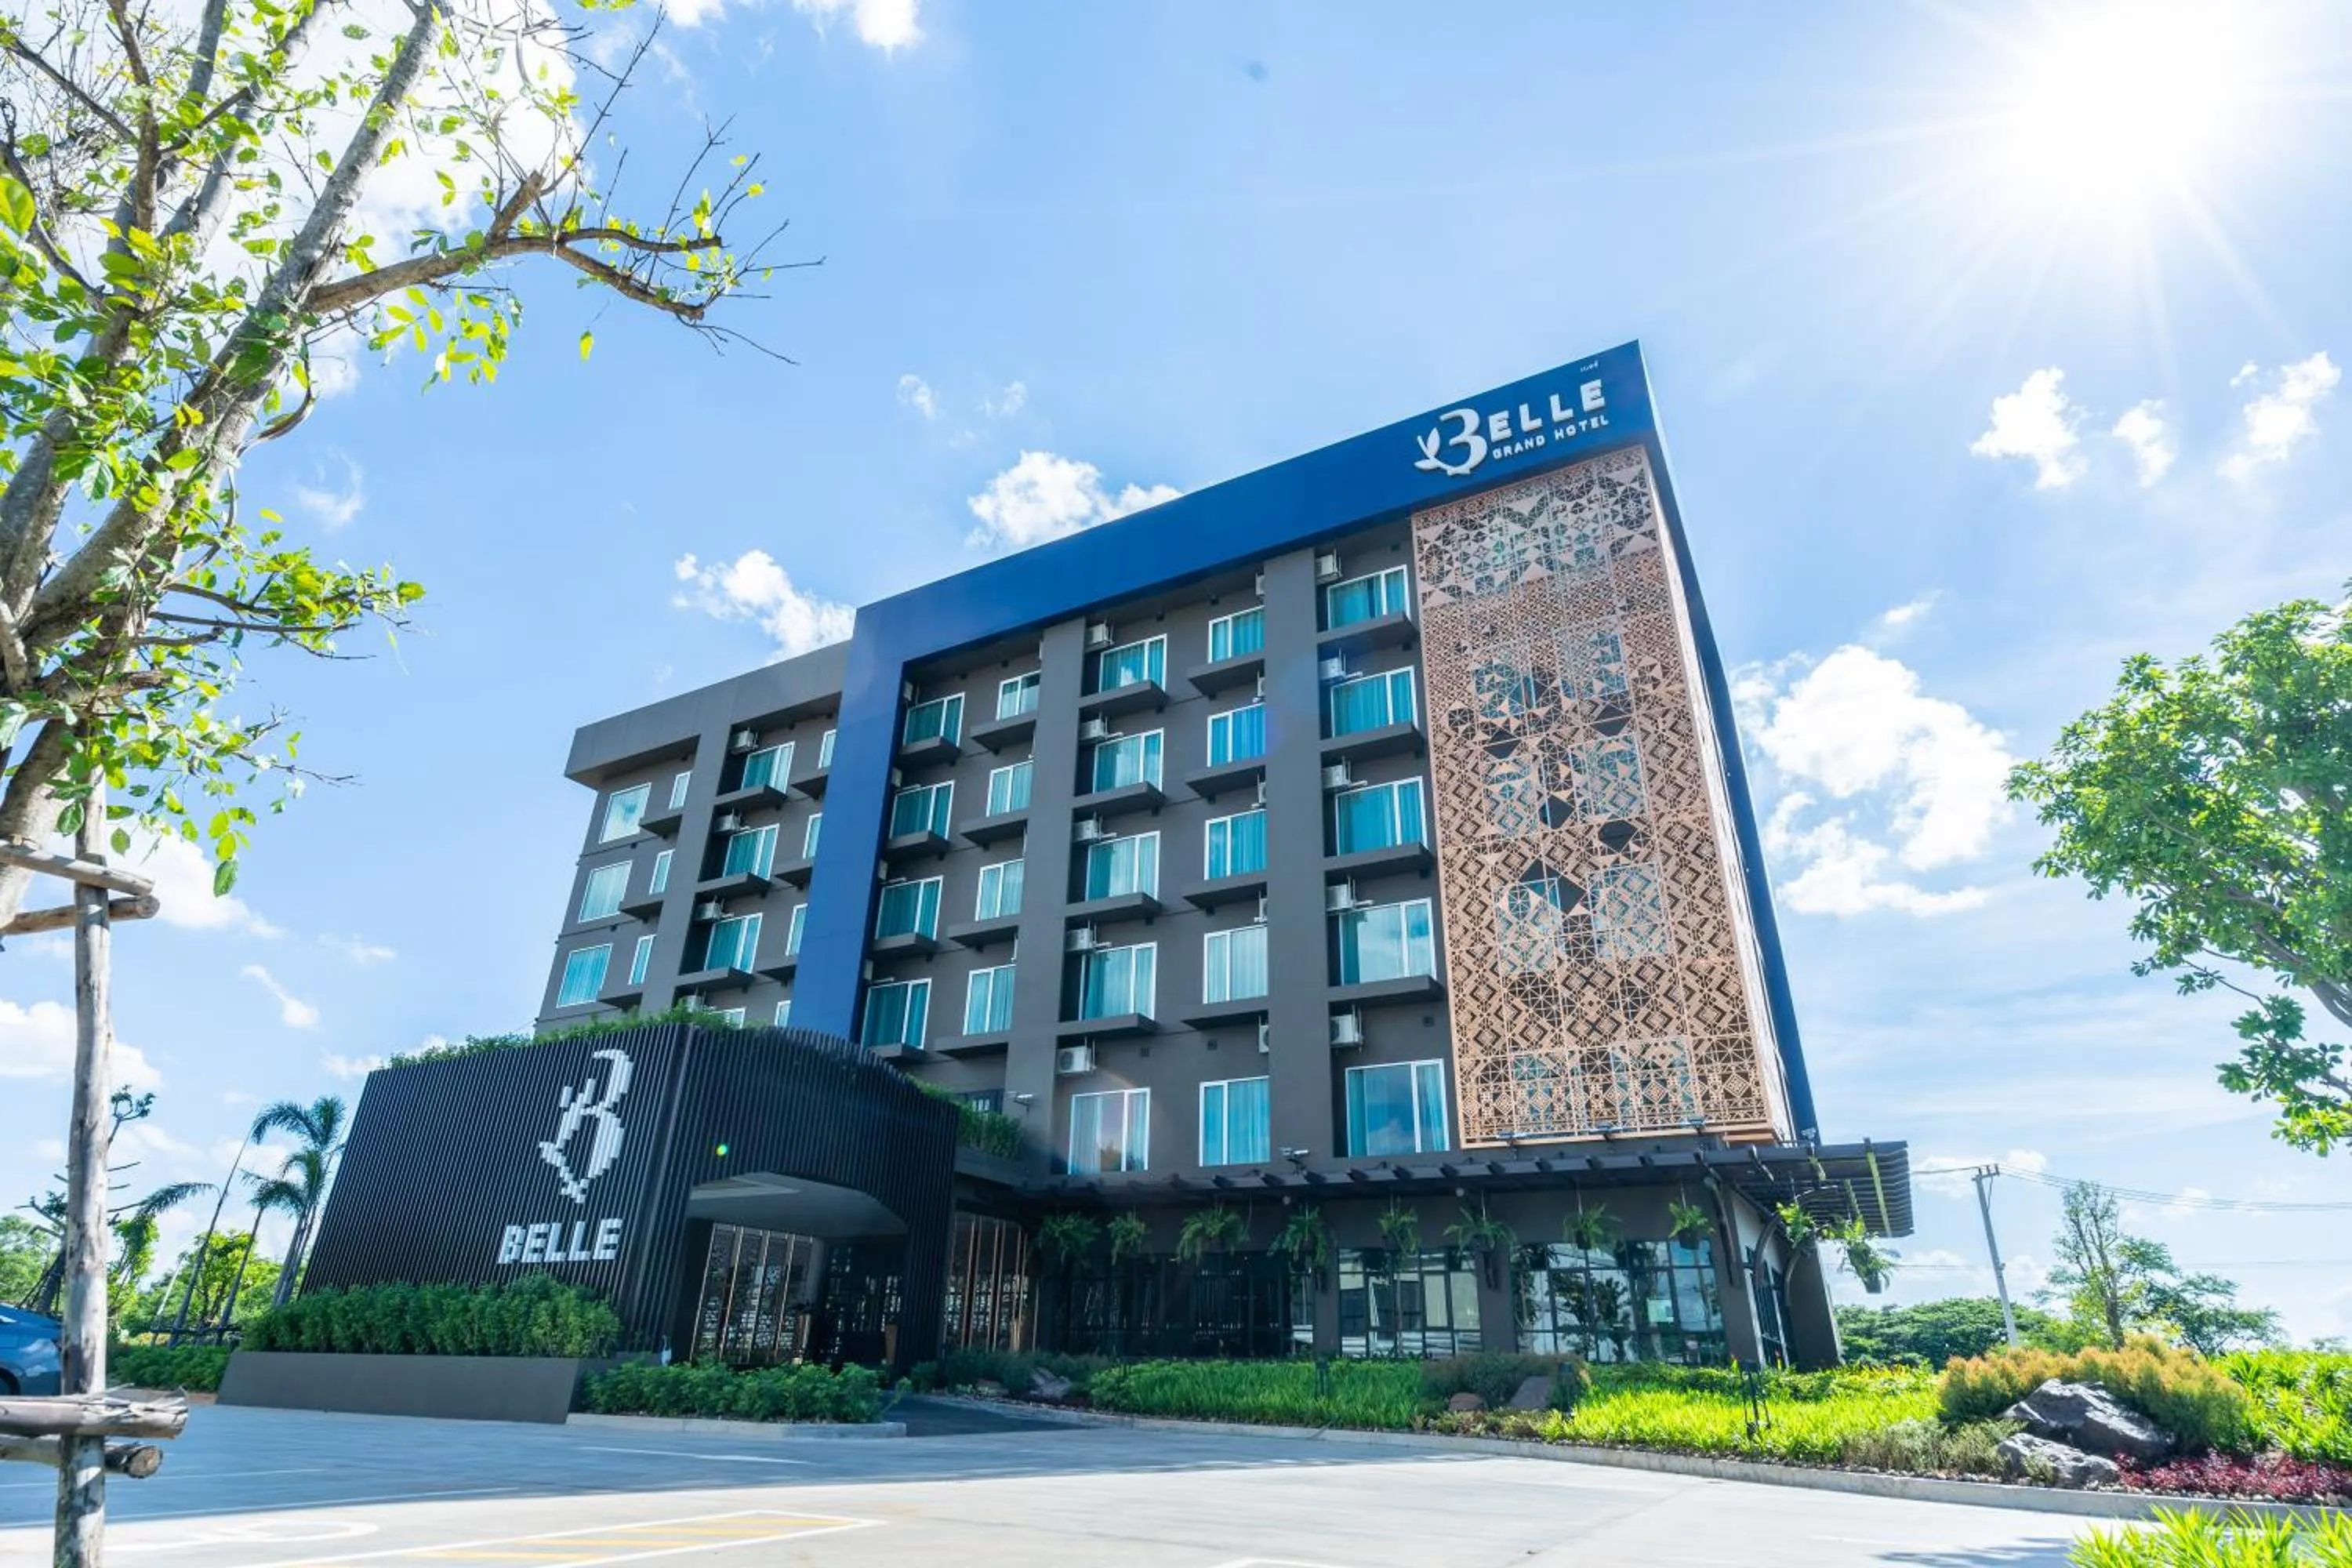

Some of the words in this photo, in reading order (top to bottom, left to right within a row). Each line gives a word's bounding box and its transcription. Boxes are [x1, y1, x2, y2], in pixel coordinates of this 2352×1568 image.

[1492, 434, 1546, 460] GRAND
[1554, 414, 1610, 440] HOTEL
[497, 1218, 624, 1265] BELLE
